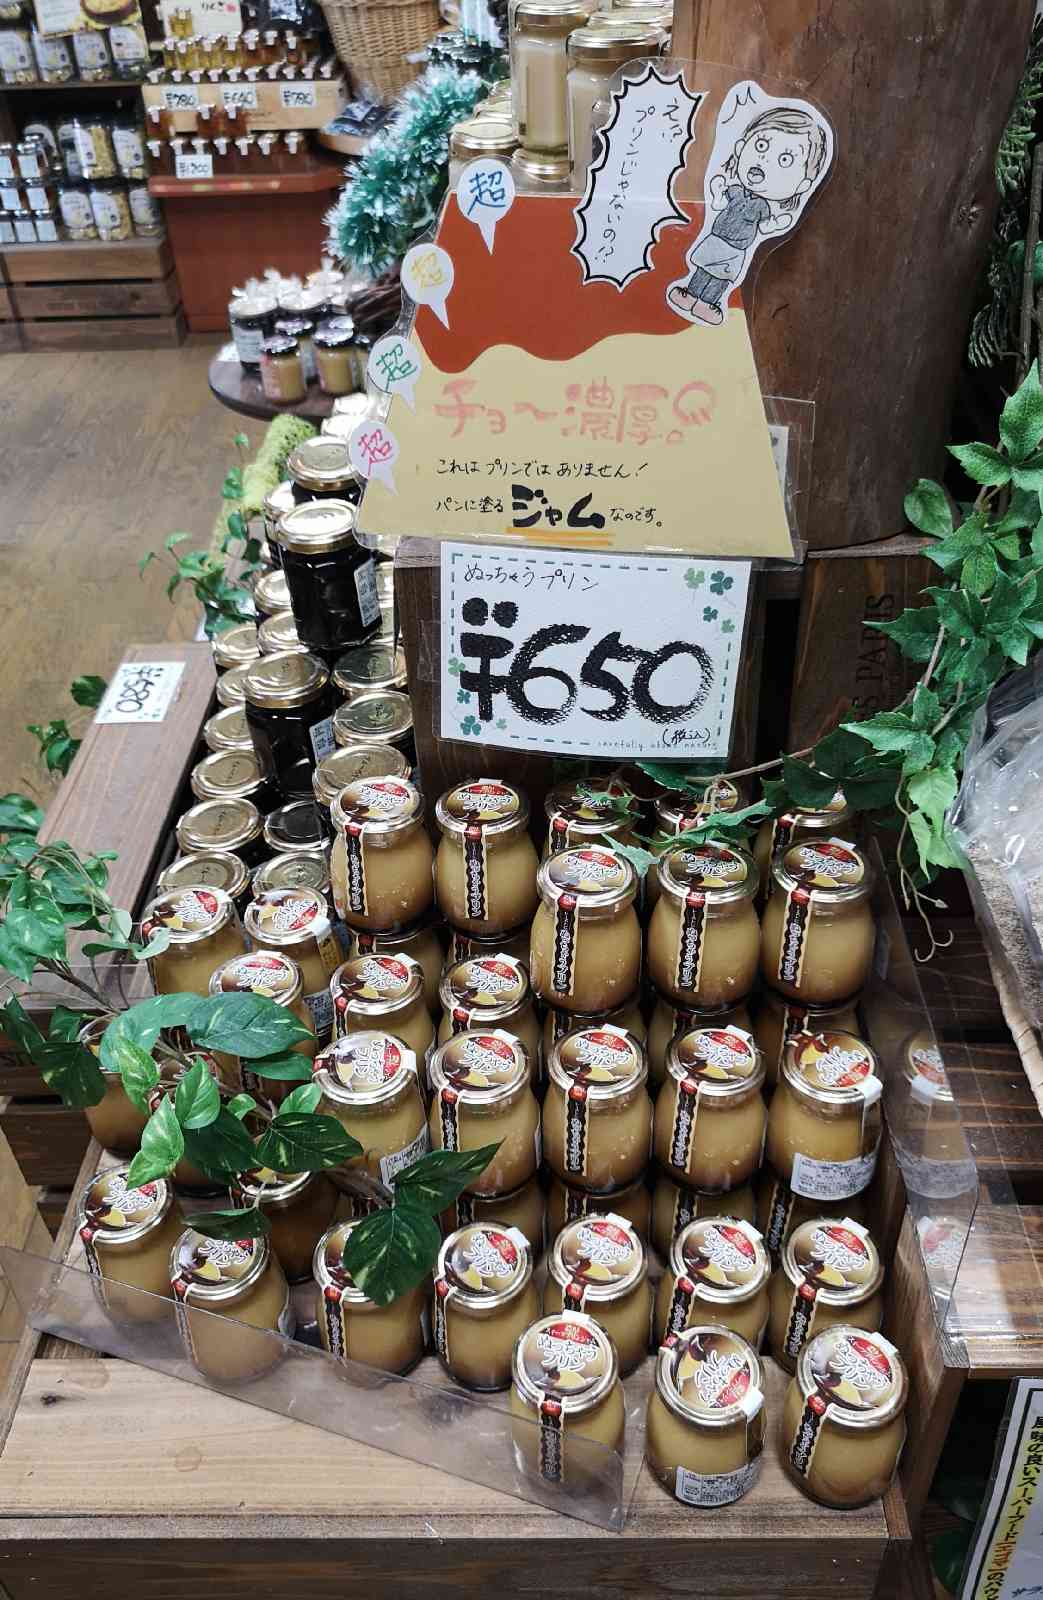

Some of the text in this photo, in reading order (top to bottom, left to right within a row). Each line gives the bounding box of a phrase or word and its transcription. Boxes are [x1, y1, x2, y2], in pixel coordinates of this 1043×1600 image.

[467, 170, 506, 216] 超
[376, 344, 418, 392] 超
[358, 429, 395, 477] 超
[464, 564, 599, 592] ぬっちゃうプリン
